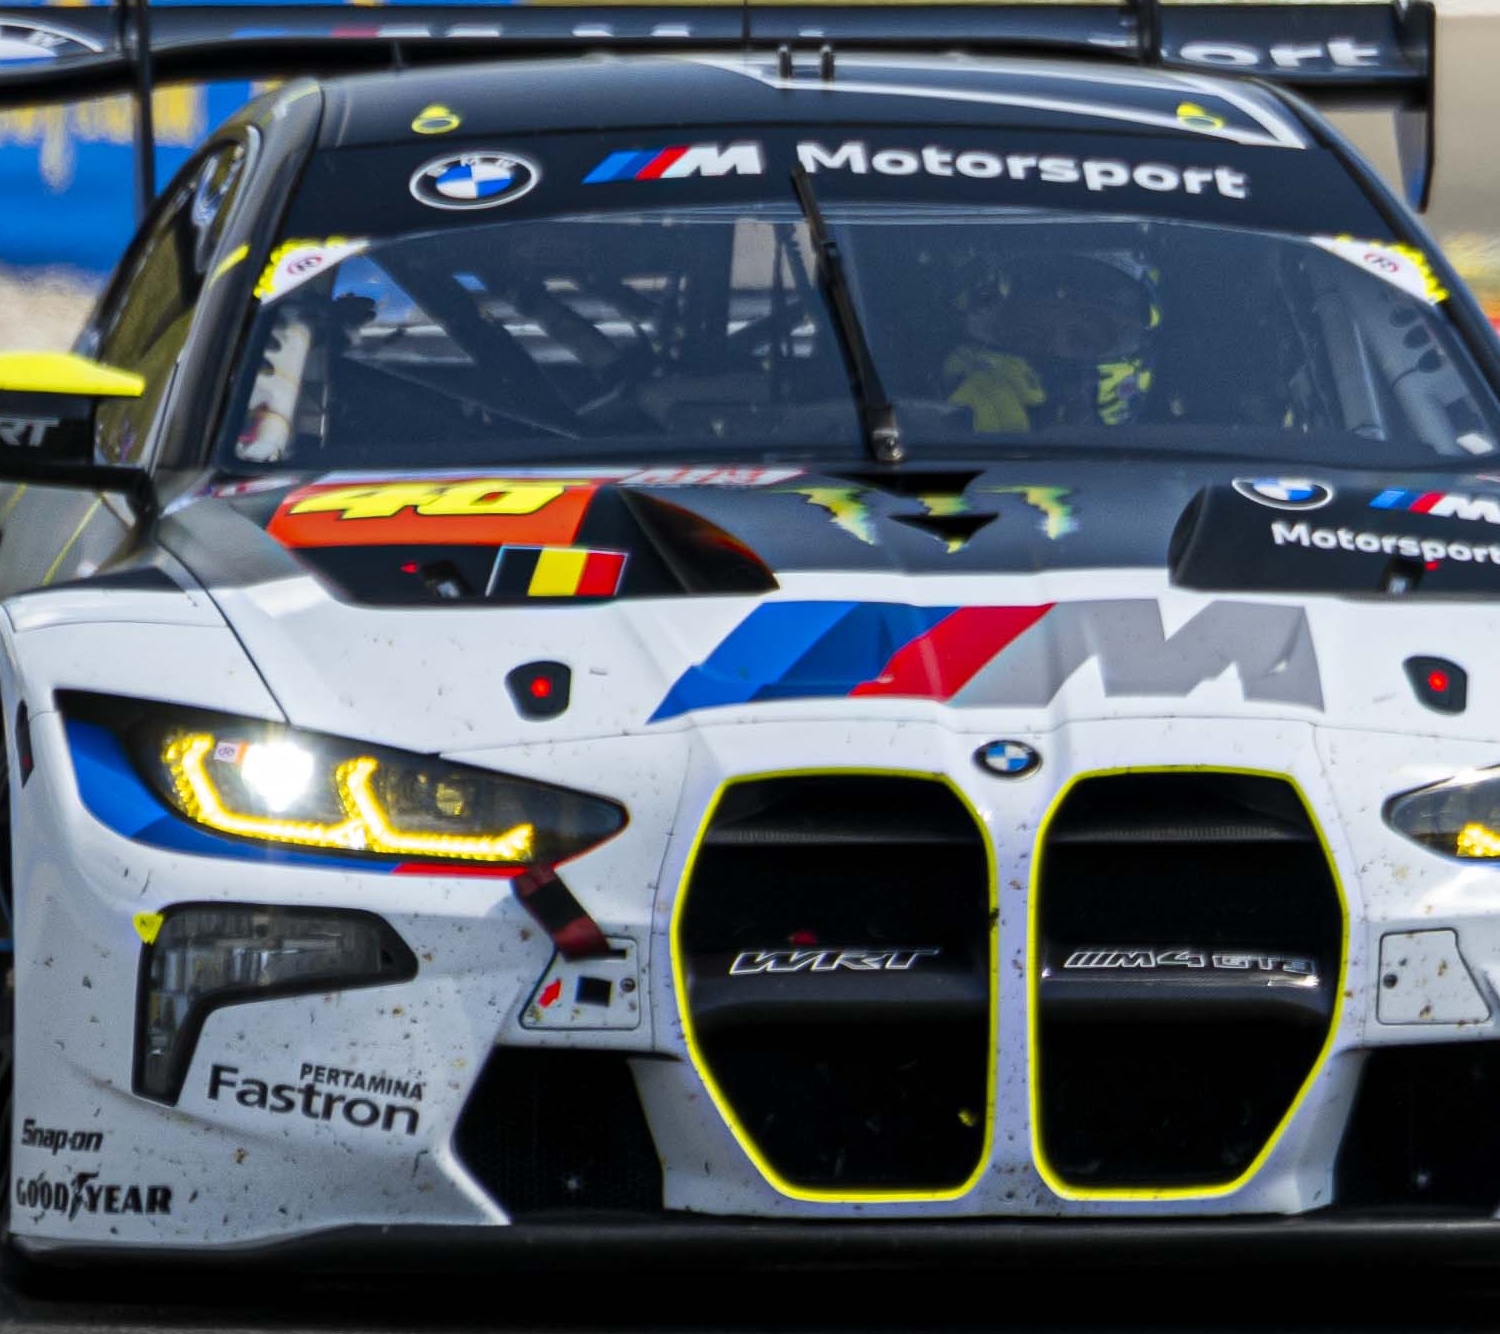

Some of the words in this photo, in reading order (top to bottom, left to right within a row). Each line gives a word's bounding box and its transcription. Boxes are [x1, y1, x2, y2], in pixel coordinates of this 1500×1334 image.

[796, 141, 1248, 199] Motorsport
[728, 950, 942, 976] WRT
[207, 1063, 420, 1136] Fastron
[299, 1062, 425, 1102] PERTAMINA
[20, 1117, 105, 1156] Snap-on
[15, 1171, 173, 1223] GOODYEAR
